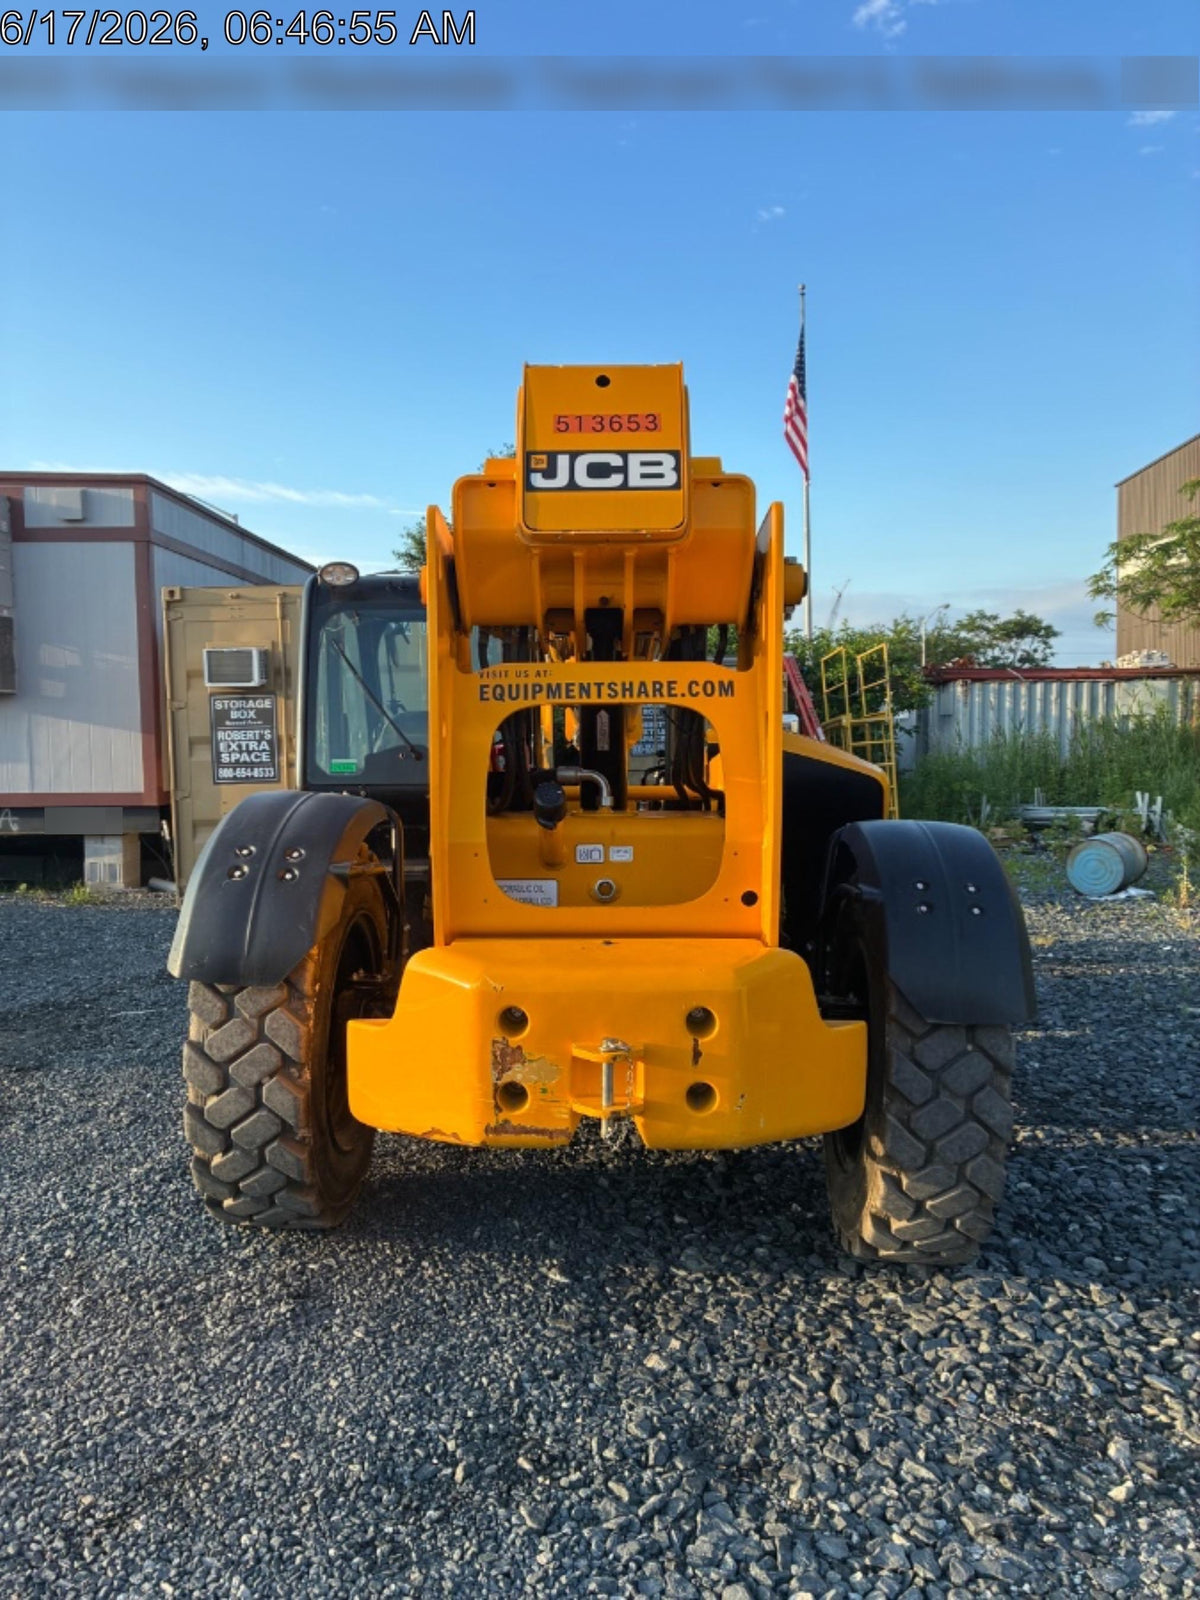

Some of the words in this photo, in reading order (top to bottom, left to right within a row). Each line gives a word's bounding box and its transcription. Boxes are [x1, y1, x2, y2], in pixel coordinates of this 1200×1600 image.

[556, 414, 658, 432] 513653
[530, 452, 678, 488] JCB
[479, 669, 509, 679] VISIT
[515, 669, 529, 678] US
[534, 669, 552, 678] AT:
[479, 680, 735, 703] EQUIPMENTSHARE.COM
[214, 699, 272, 710] STORAGE
[230, 709, 256, 719] BOX
[217, 729, 272, 741] ROBERT'S
[220, 741, 270, 752] EXTRA
[221, 752, 271, 763] SPACE
